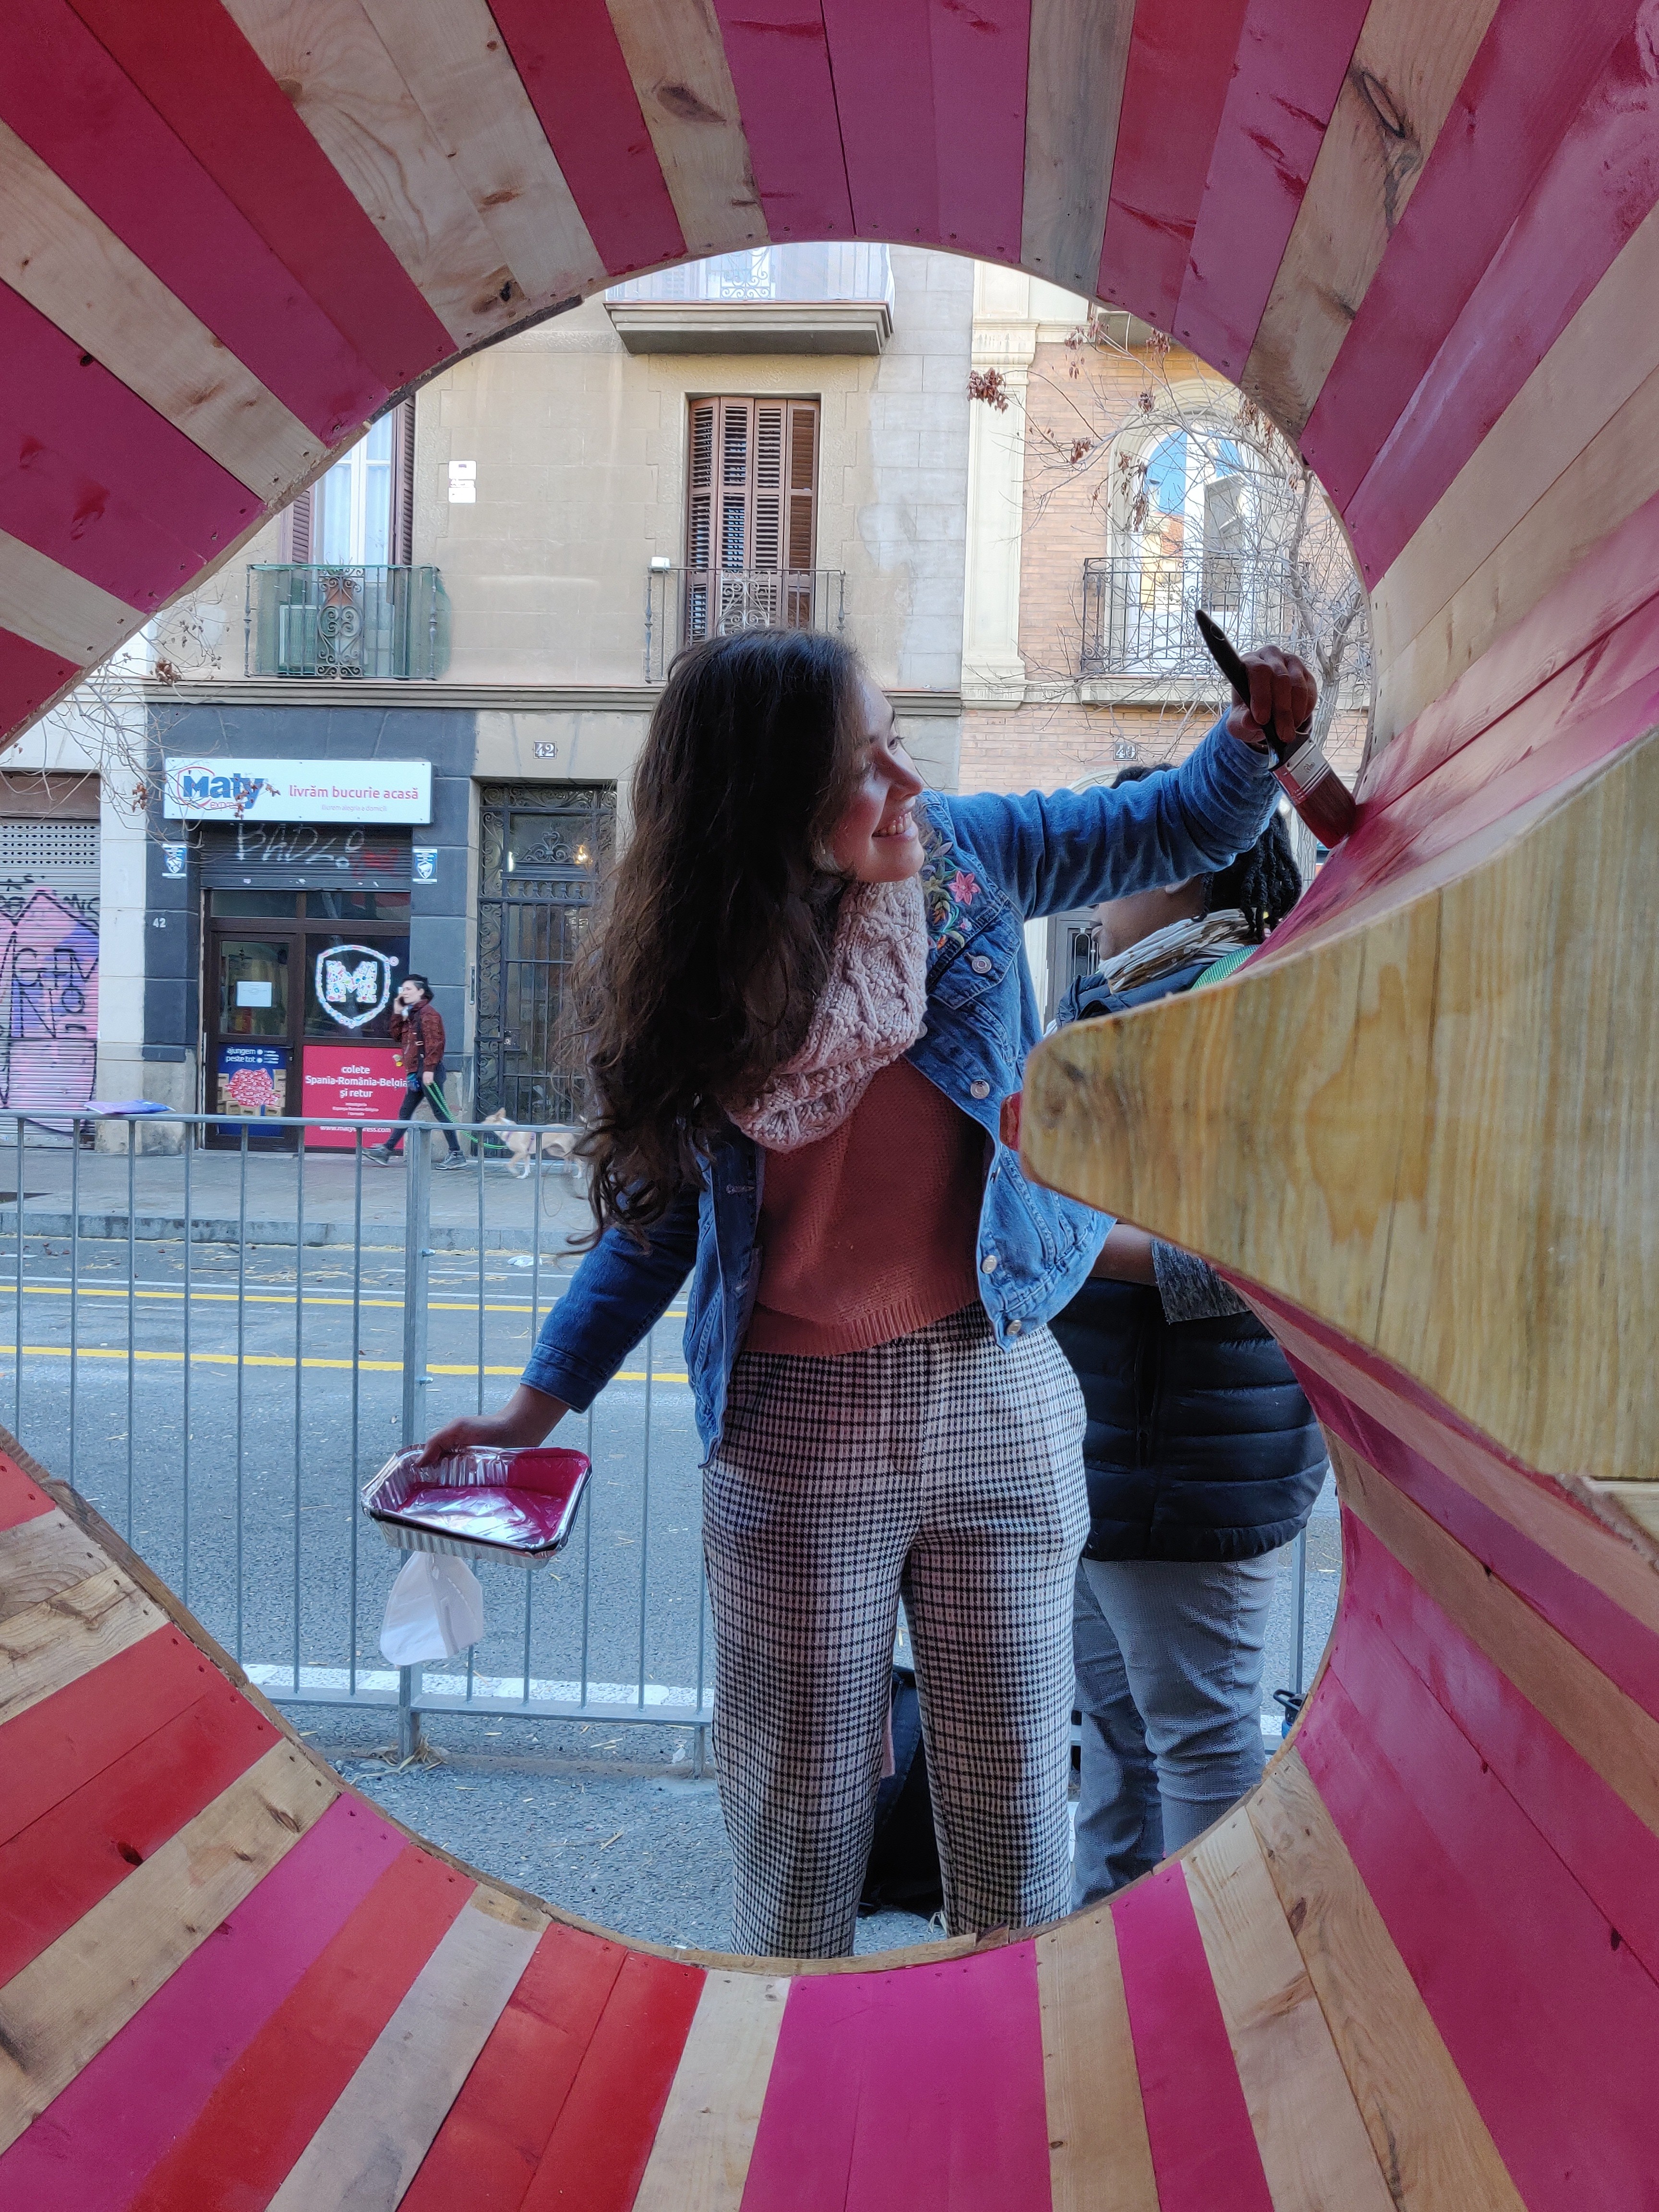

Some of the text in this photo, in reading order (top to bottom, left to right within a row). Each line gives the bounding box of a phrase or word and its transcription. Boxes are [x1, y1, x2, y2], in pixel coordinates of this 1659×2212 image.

[535, 743, 554, 757] 42
[1116, 745, 1136, 758] 40
[183, 773, 267, 810] Maty
[289, 784, 419, 800] livrăm bucurie acasă
[153, 917, 166, 928] 42
[227, 1047, 256, 1056] ajungem
[341, 1065, 371, 1074] colete
[349, 1089, 373, 1097] retur
